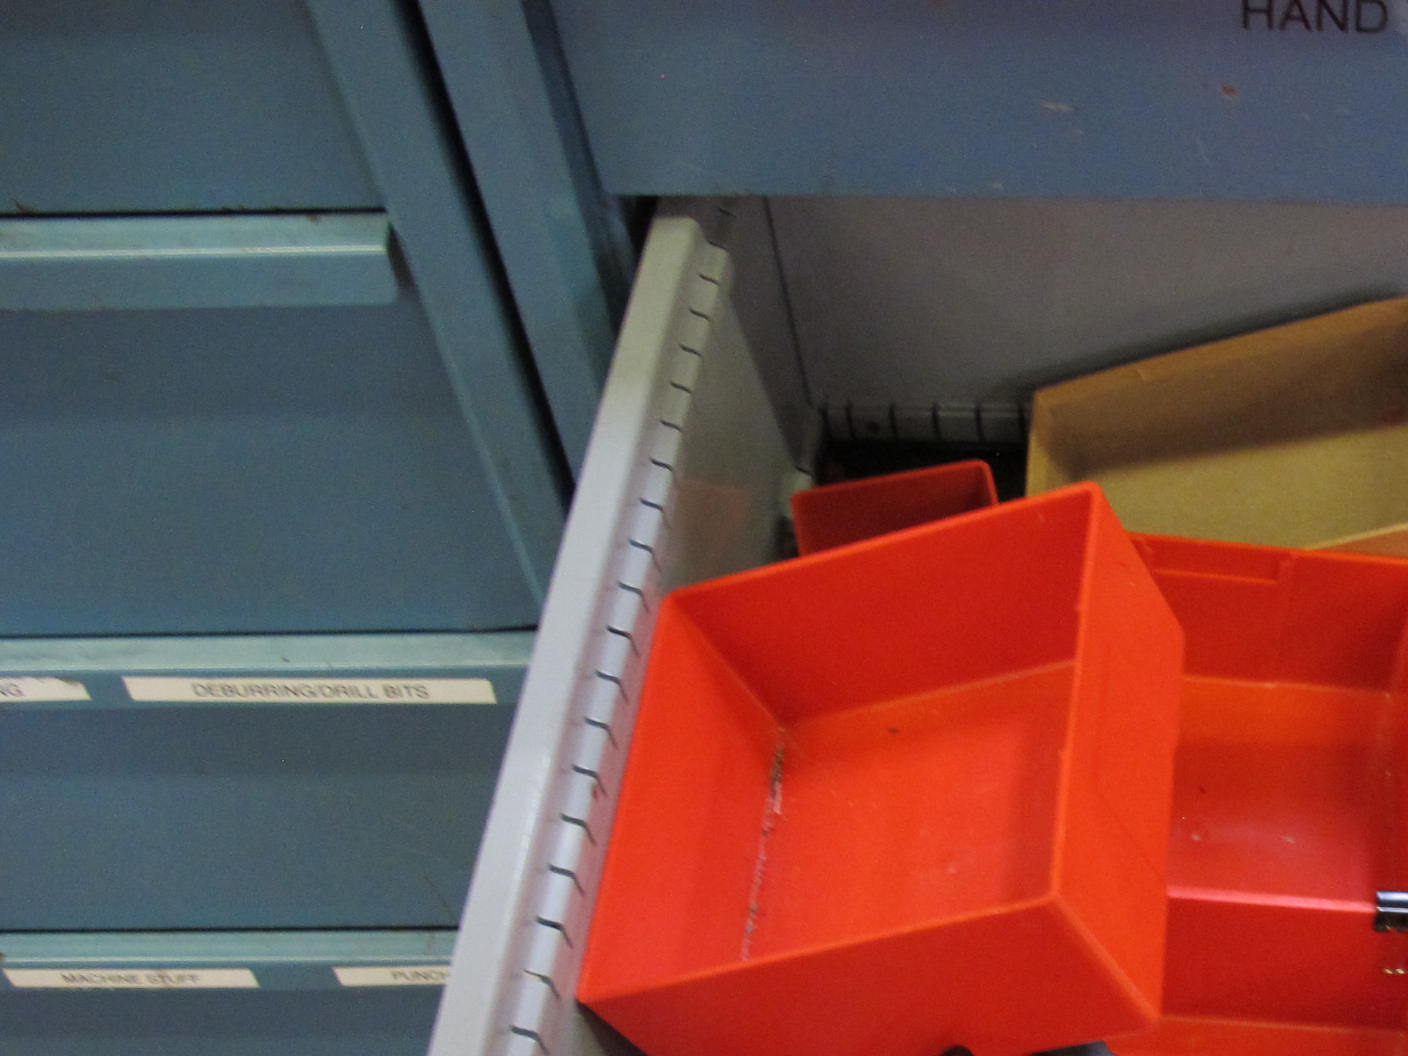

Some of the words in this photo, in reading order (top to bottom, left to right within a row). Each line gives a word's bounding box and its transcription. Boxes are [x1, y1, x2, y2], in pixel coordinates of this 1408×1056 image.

[1241, 0, 1388, 34] HAND
[382, 684, 431, 700] BITS
[60, 972, 144, 985] MACHINE
[145, 973, 201, 986] STUFF
